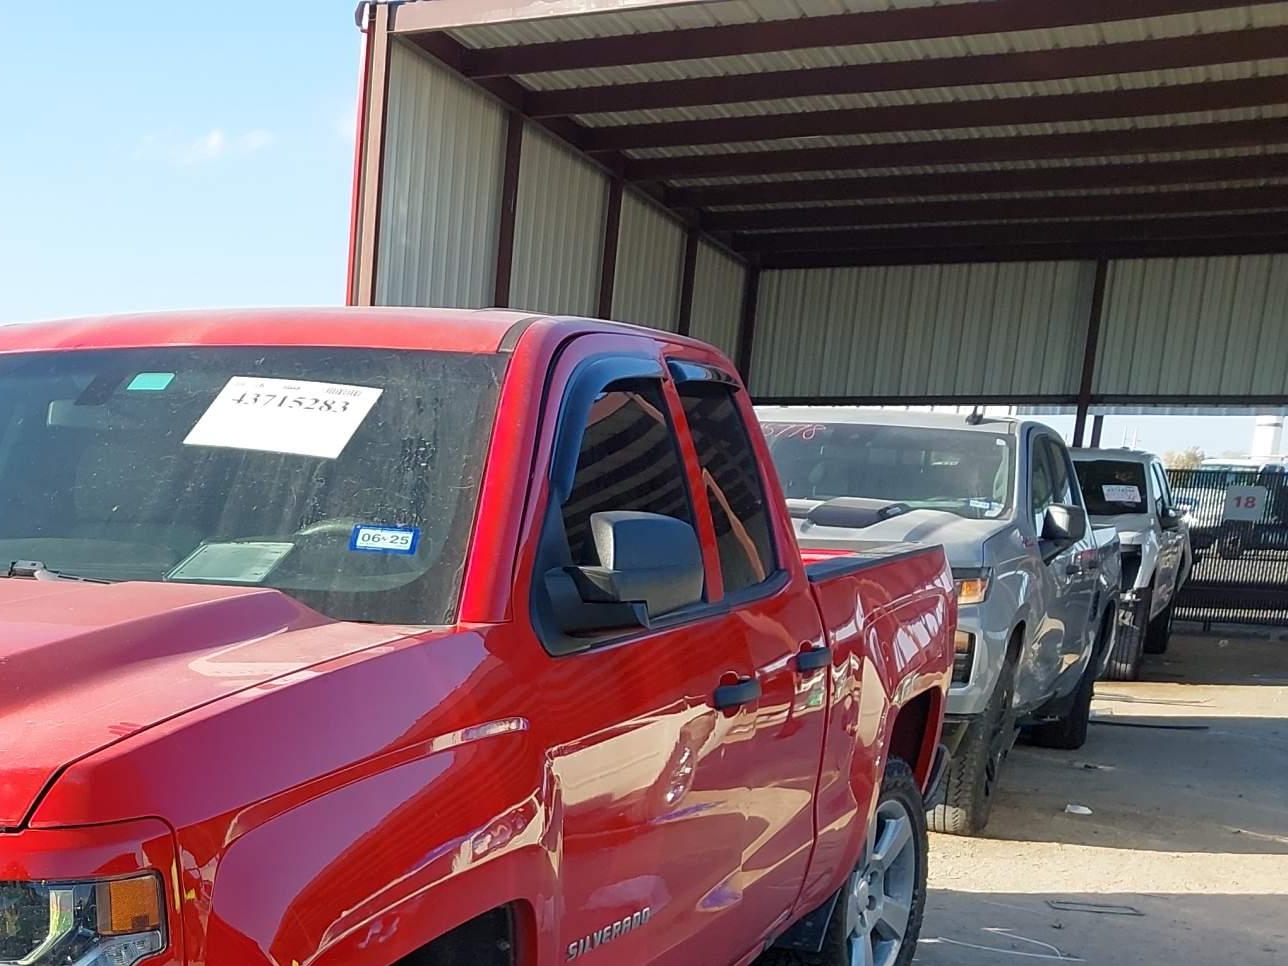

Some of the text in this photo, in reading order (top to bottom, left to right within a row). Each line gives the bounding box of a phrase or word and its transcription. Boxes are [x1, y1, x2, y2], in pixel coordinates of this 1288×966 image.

[232, 392, 350, 413] 43715283
[1233, 496, 1257, 508] 18
[361, 533, 409, 545] 06 25
[567, 906, 651, 961] SILVERADO
